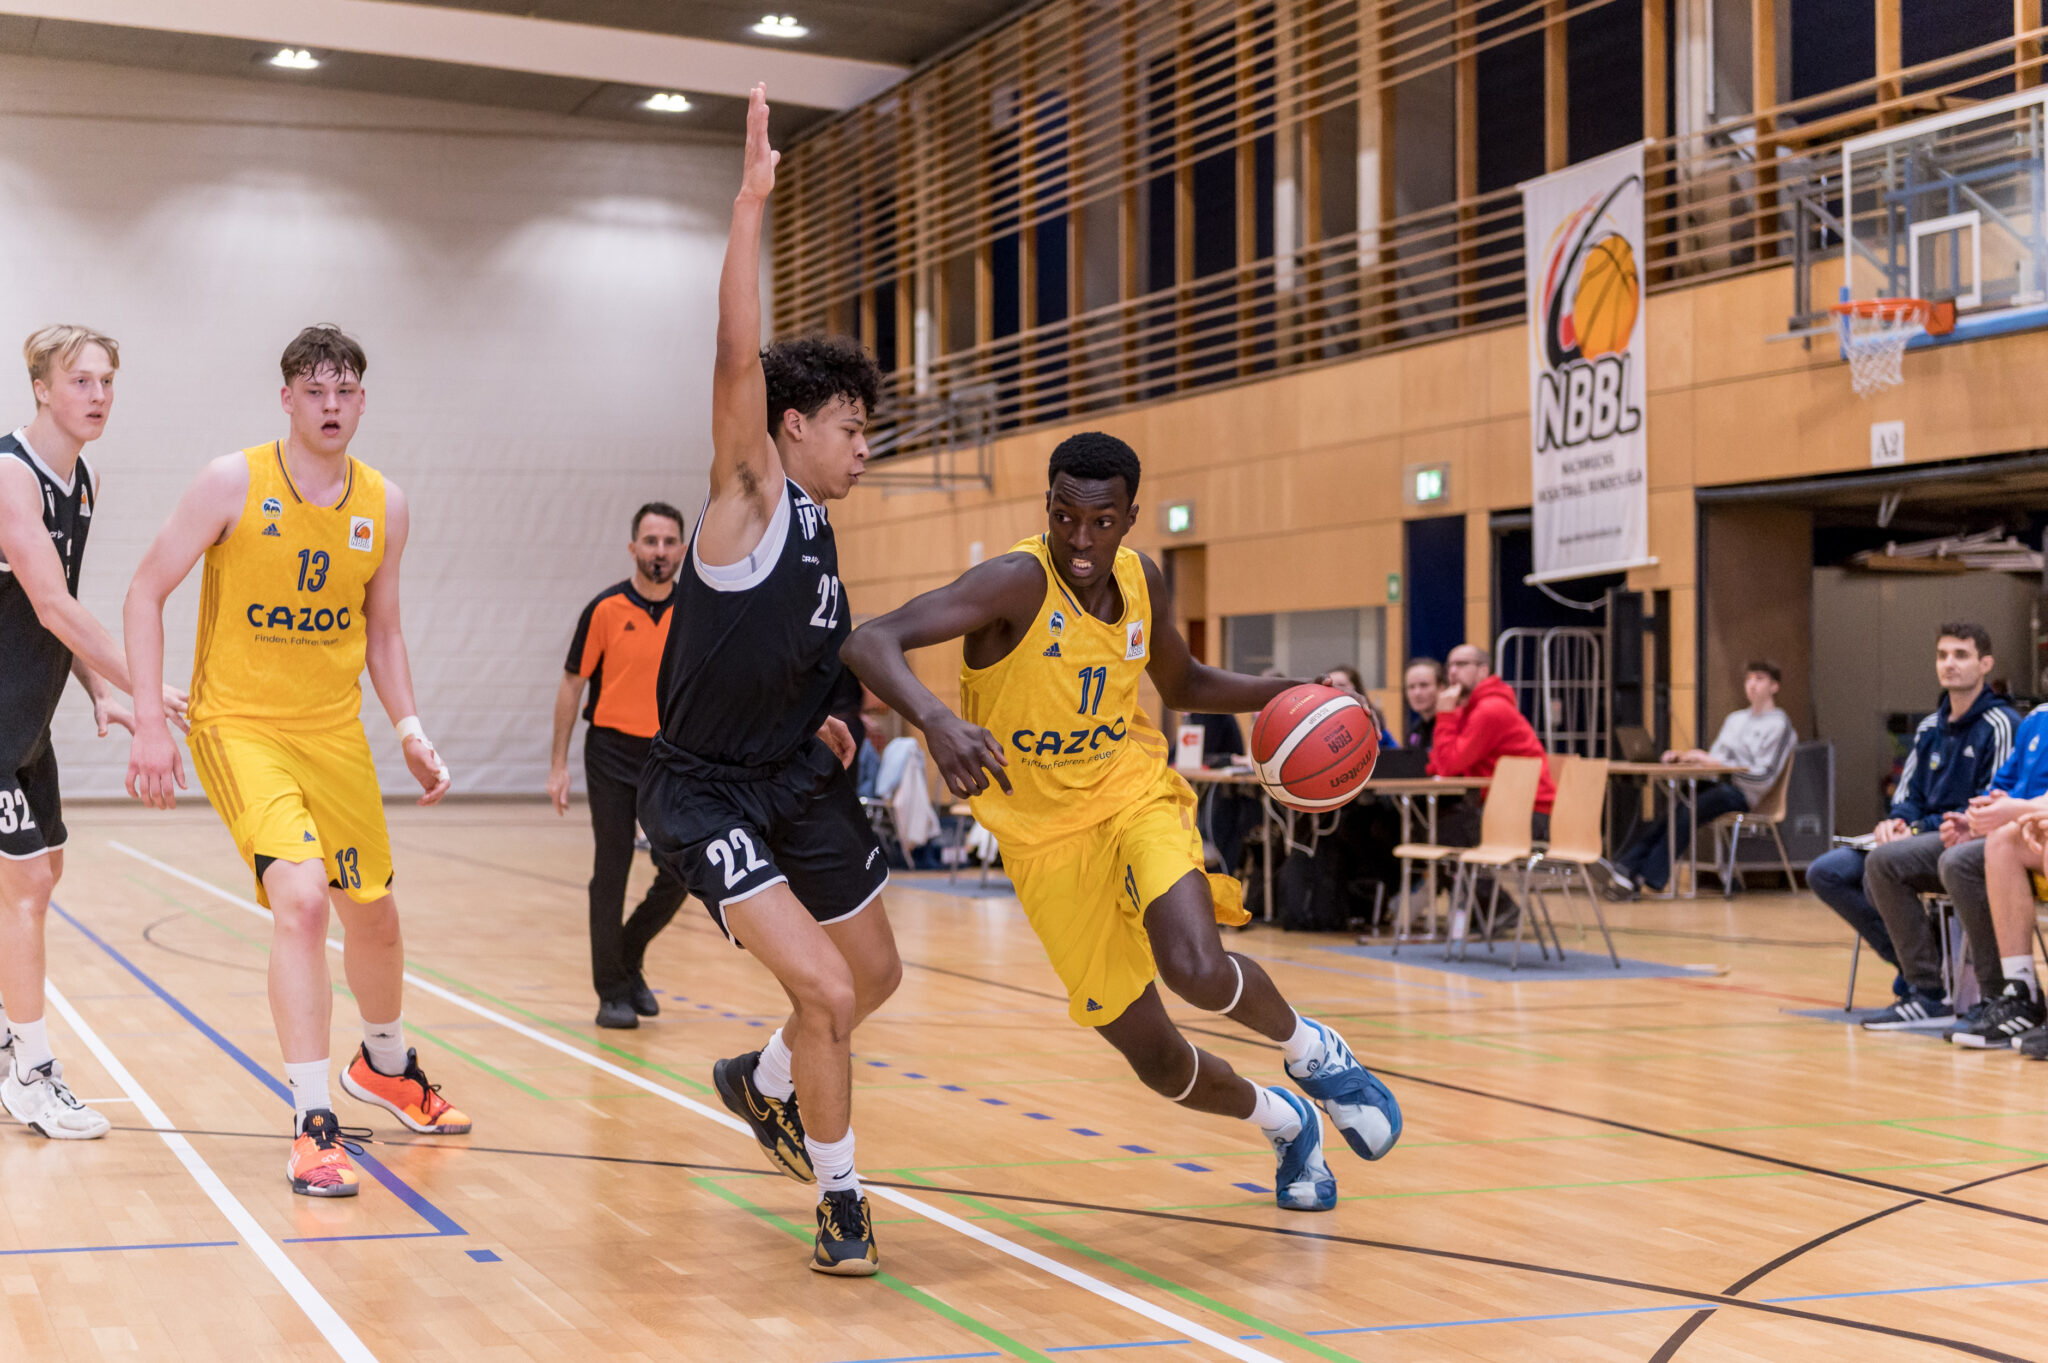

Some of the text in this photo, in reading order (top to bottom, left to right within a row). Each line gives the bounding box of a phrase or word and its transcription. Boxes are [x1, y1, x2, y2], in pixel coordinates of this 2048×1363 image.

[1536, 353, 1642, 453] NBBL
[297, 548, 330, 593] 13
[247, 603, 351, 632] CAZOO
[809, 573, 839, 629] 22
[1076, 666, 1107, 716] 11
[1327, 729, 1353, 754] FIBA
[1329, 749, 1372, 788] molten
[0, 788, 36, 834] 32
[335, 847, 361, 889] 13
[706, 828, 769, 890] 22
